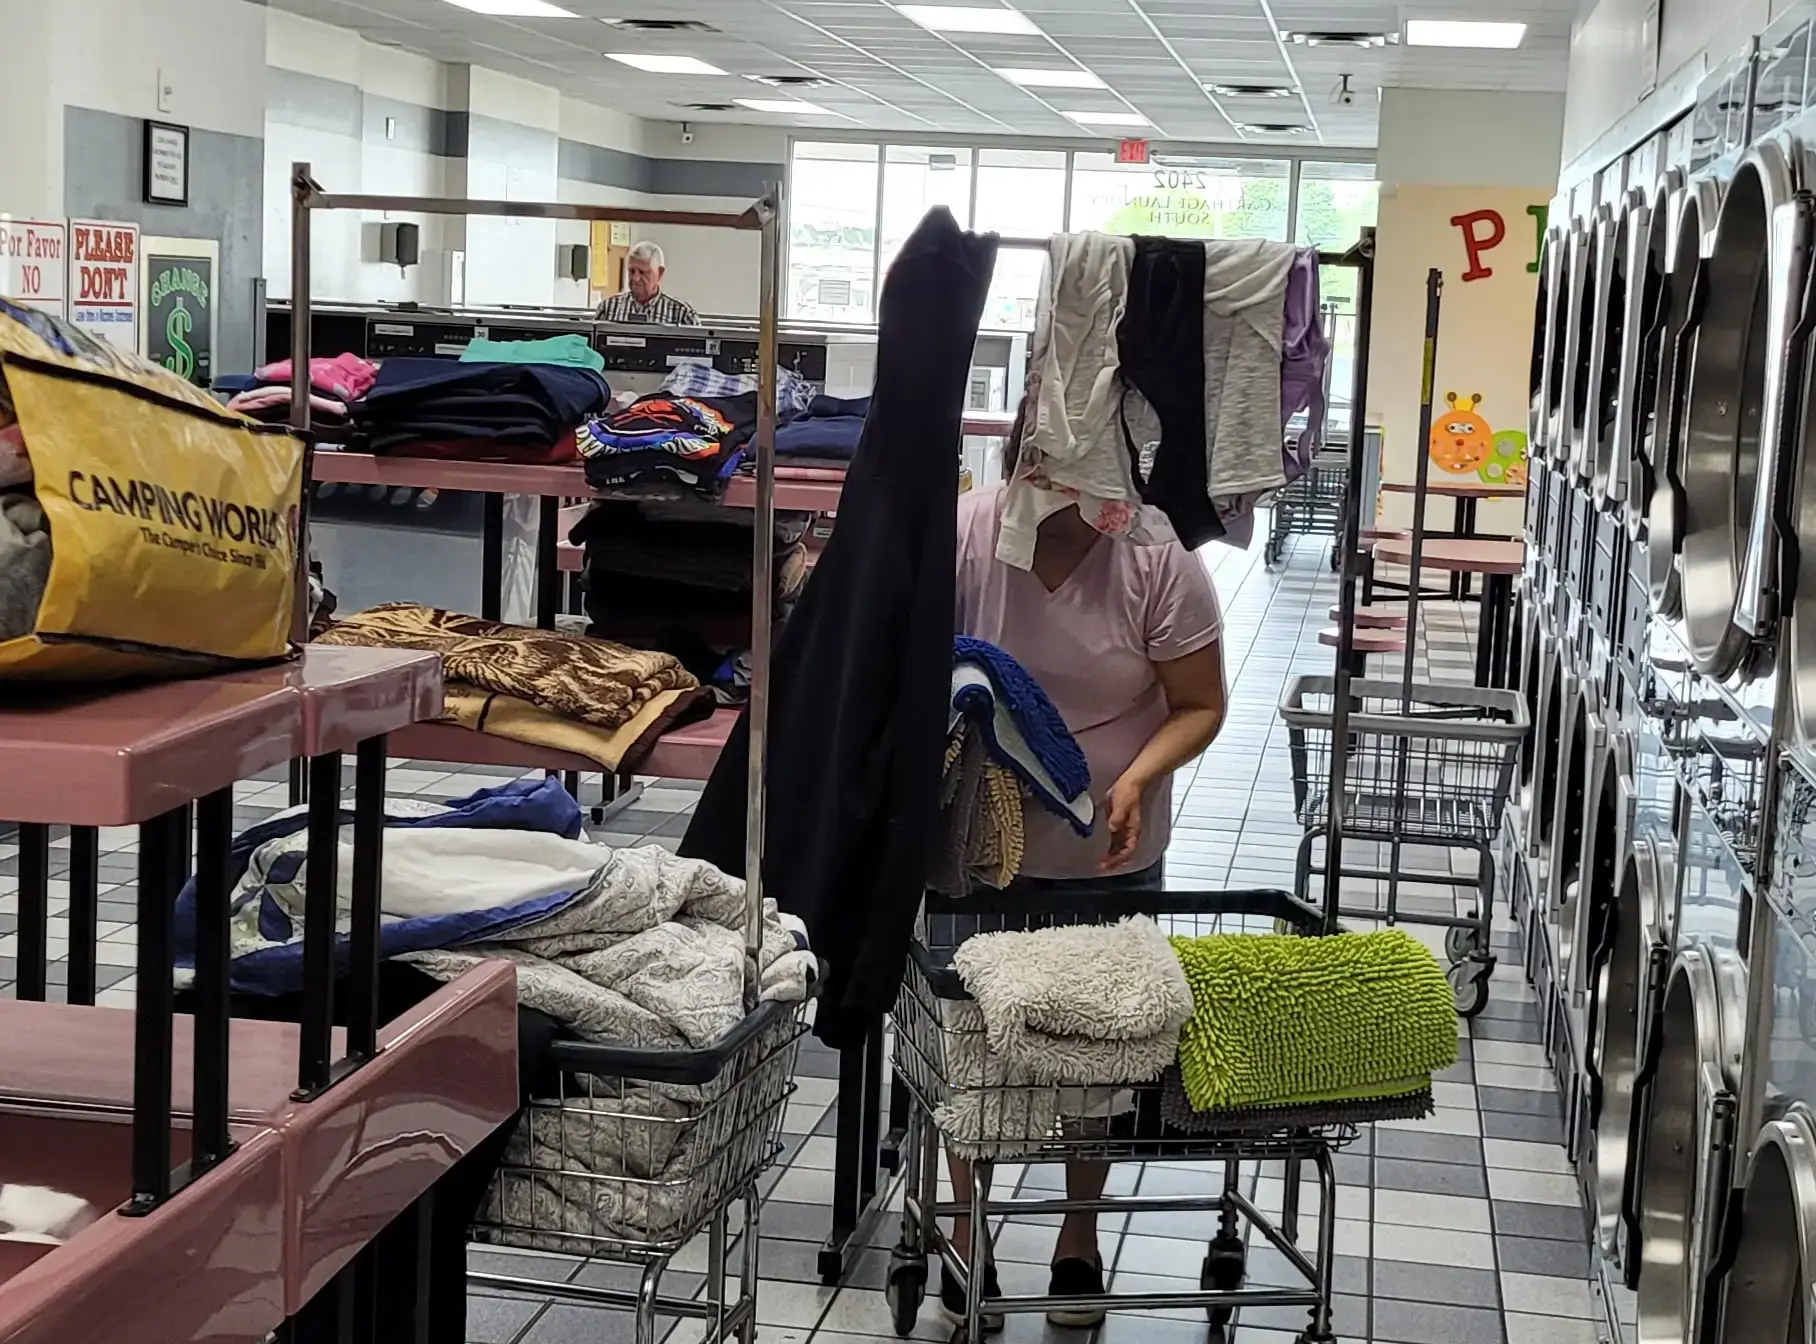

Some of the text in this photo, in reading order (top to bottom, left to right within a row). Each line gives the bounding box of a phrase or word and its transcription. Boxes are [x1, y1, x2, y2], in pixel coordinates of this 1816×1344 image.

[1120, 140, 1146, 161] EXIT
[0, 227, 61, 259] Por Favor
[74, 228, 134, 264] PLEASE
[22, 265, 41, 294] NO
[80, 266, 128, 300] DON'T
[151, 267, 209, 308] CHANGE
[69, 470, 202, 533] CAMPING
